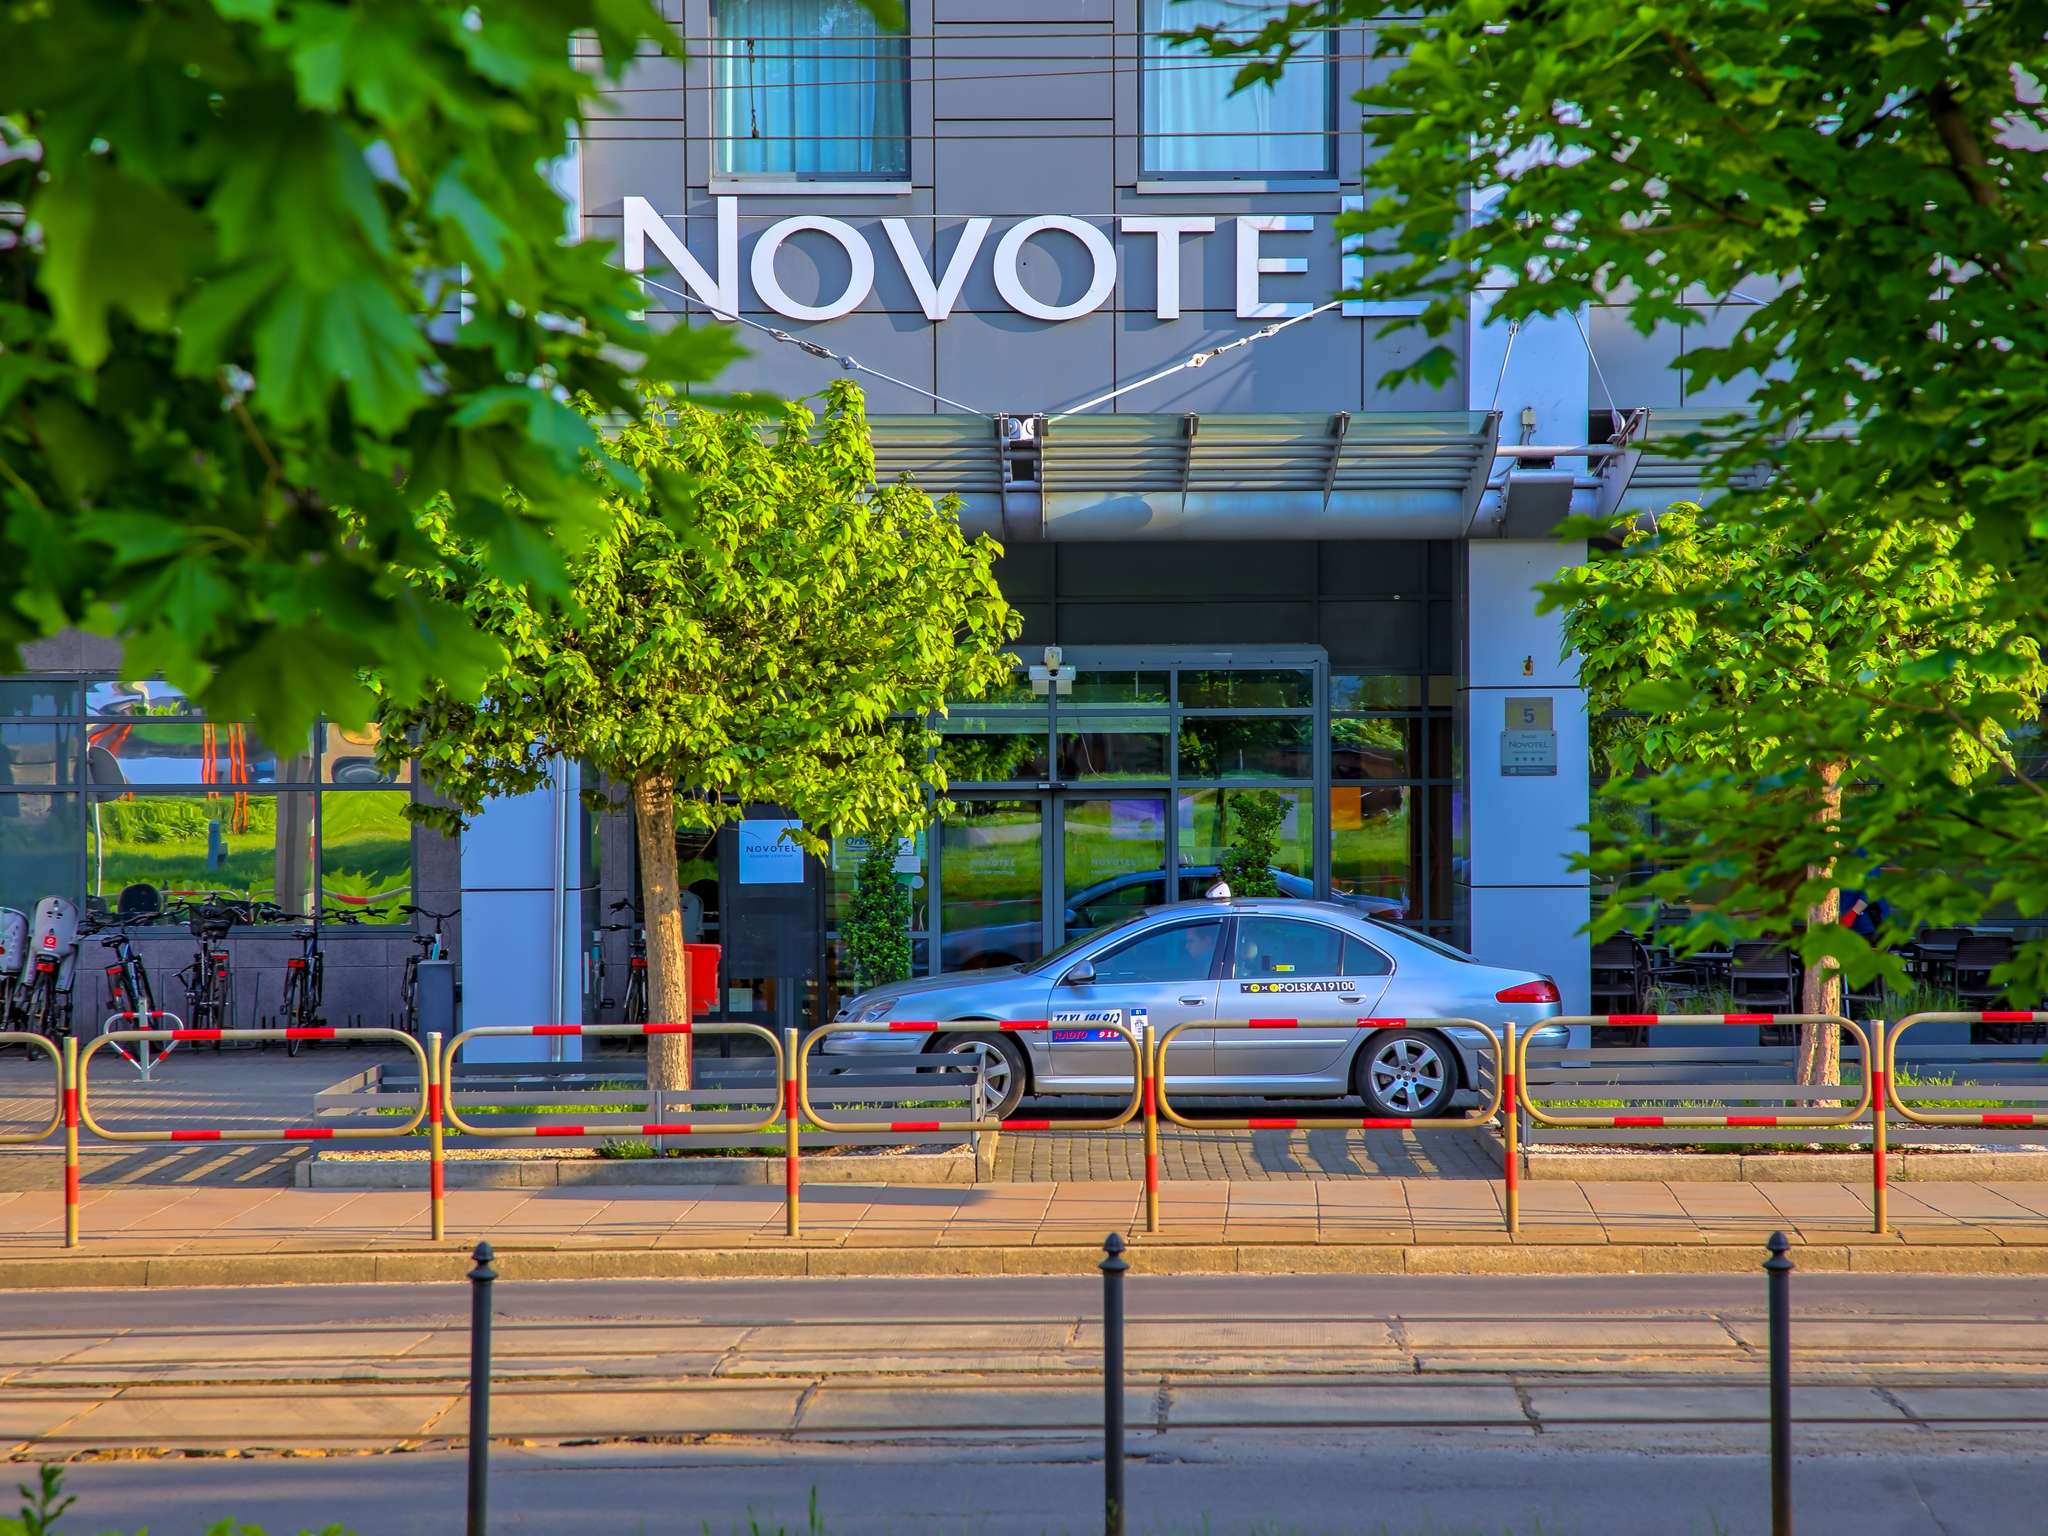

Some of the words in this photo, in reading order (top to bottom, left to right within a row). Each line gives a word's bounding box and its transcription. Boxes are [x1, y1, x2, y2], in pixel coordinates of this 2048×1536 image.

[623, 194, 1432, 322] NOVOTEL
[1523, 707, 1535, 724] 5
[745, 845, 797, 853] NOVOTEL
